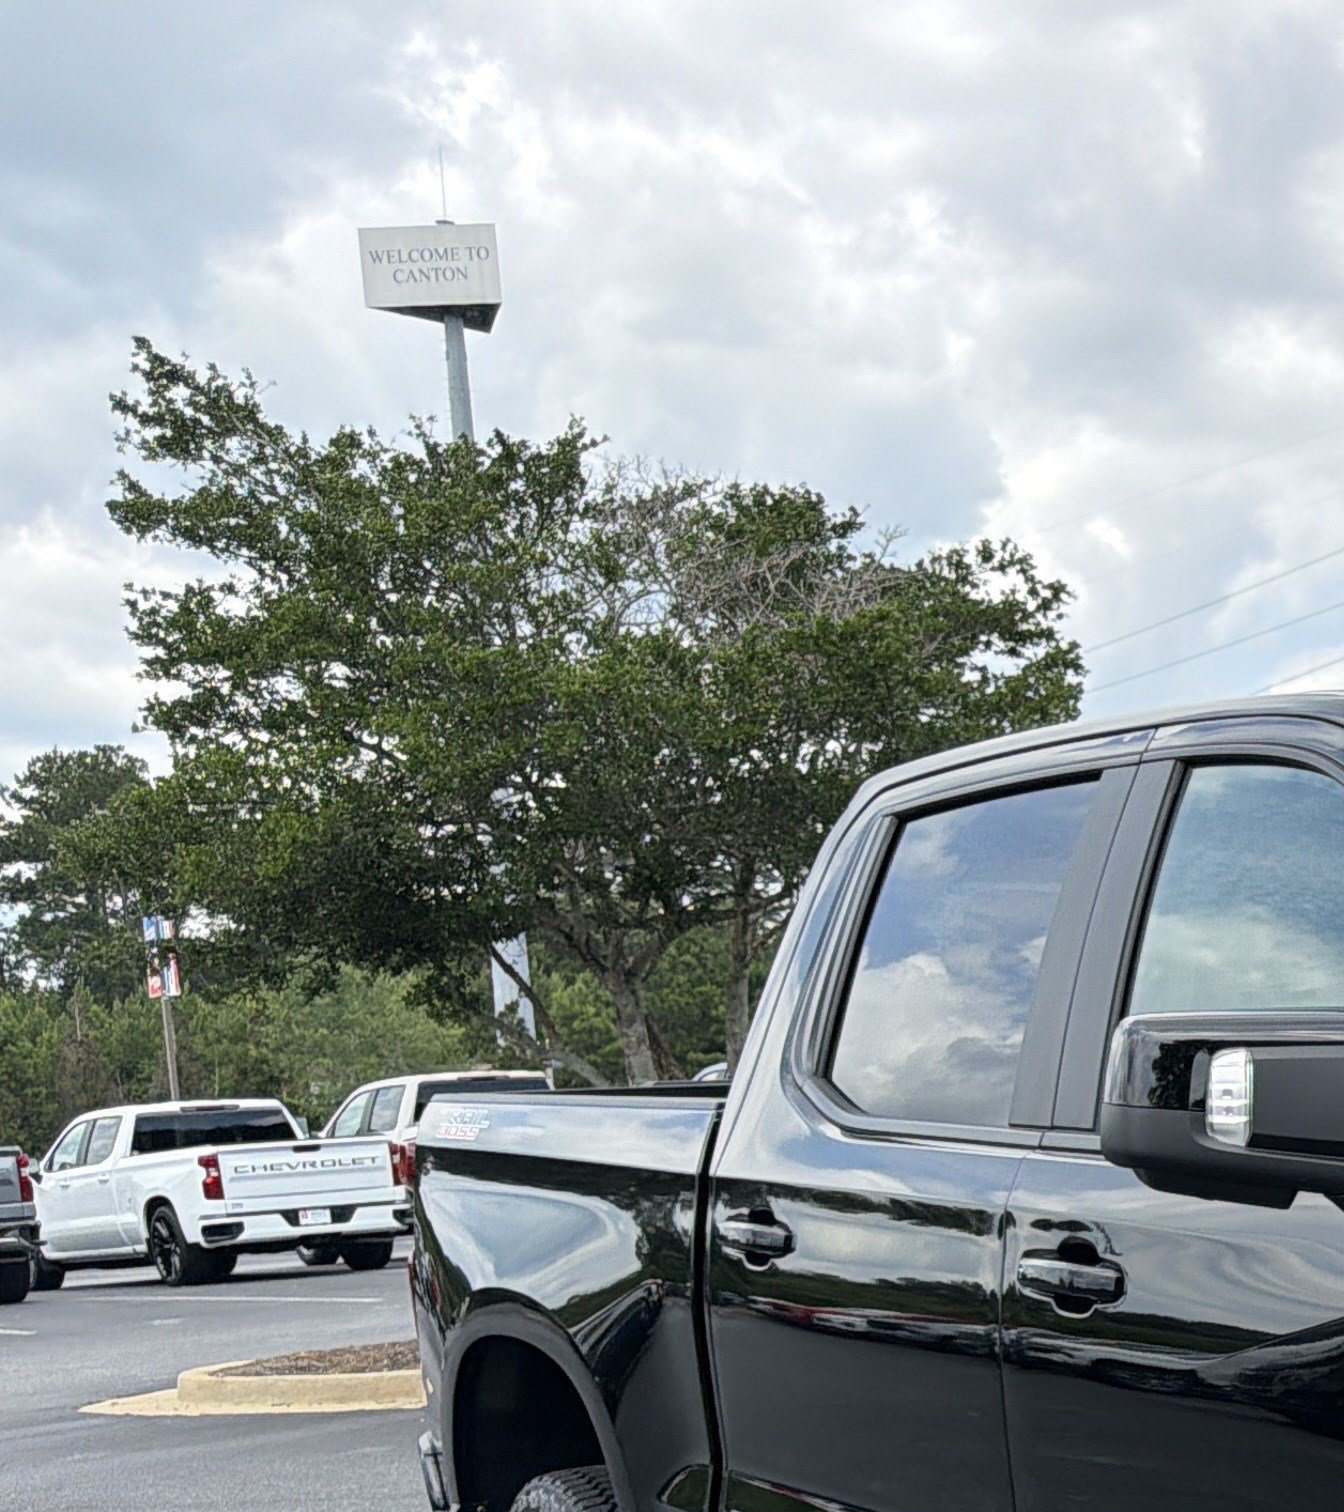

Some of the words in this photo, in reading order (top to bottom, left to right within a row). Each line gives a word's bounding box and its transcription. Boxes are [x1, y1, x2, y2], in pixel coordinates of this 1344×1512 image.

[368, 247, 461, 264] WELCOME
[465, 246, 490, 261] TO
[392, 266, 469, 284] CANTON
[233, 1156, 379, 1174] CHEVROLET
